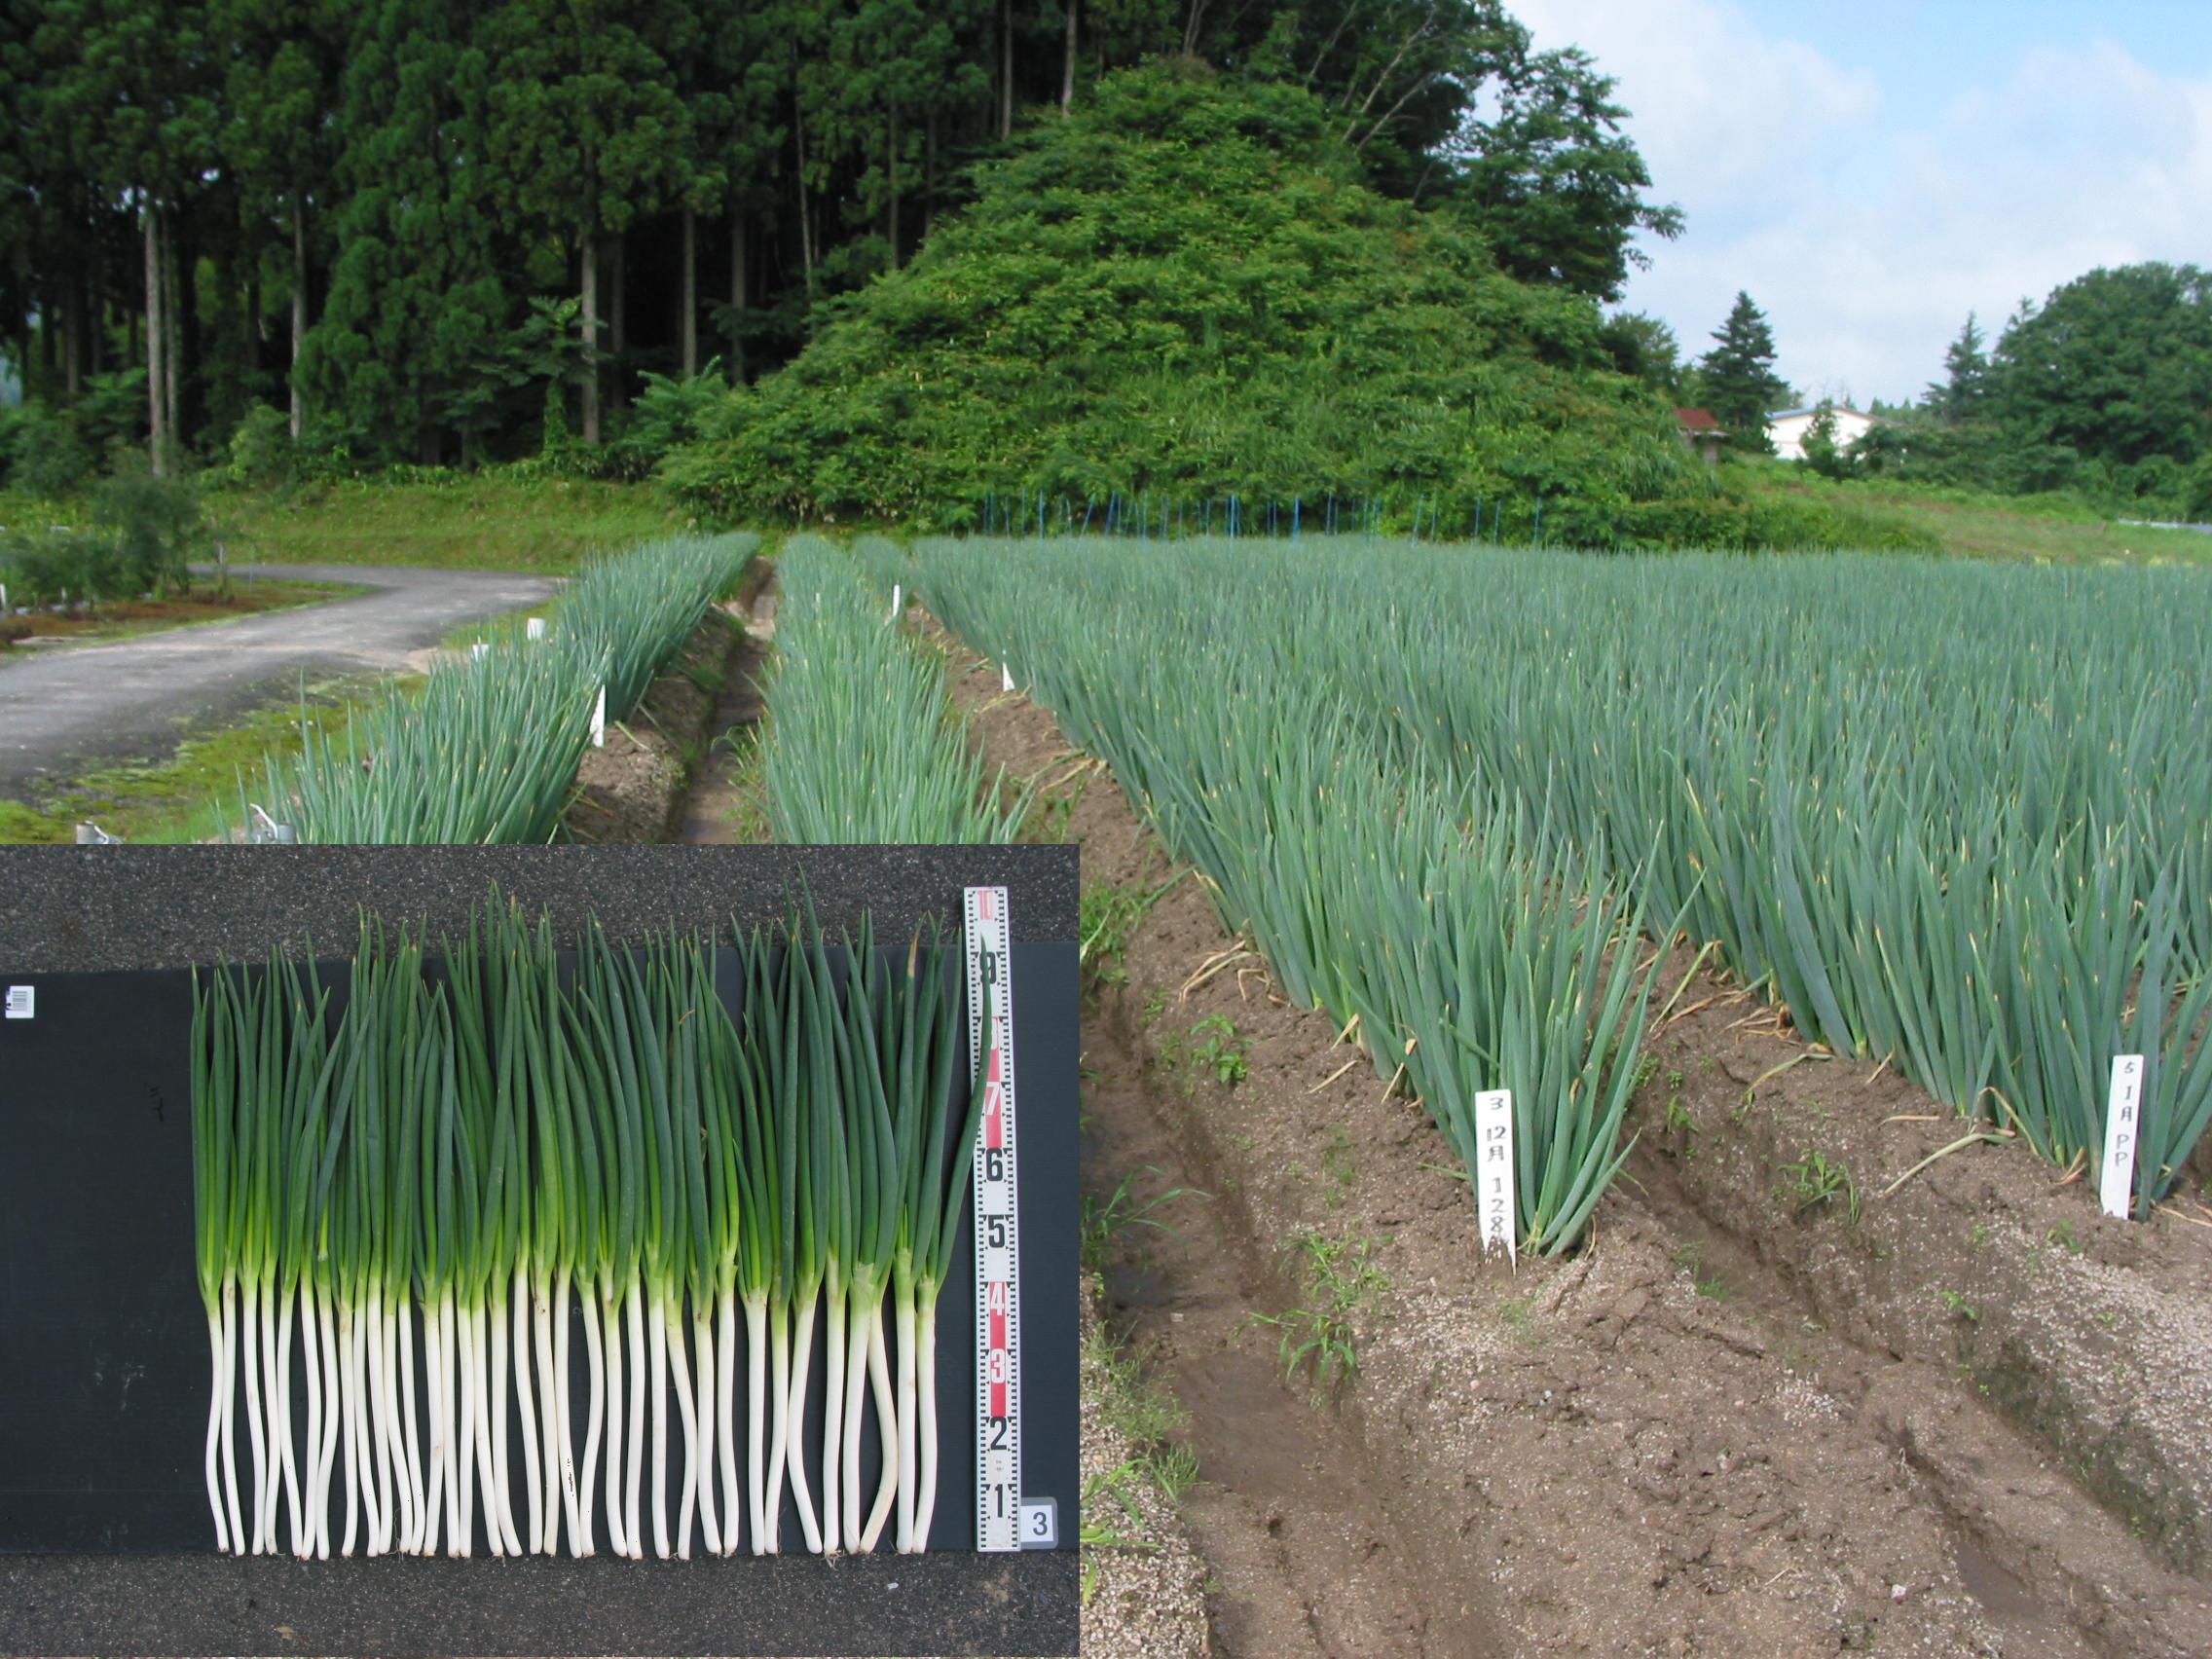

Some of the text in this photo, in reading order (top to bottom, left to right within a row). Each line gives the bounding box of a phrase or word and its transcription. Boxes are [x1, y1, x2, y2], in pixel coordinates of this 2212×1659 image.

[986, 1082, 1000, 1116] 7
[1489, 1097, 1504, 1110] 3
[985, 1148, 1004, 1182] 6
[987, 1215, 1005, 1248] 5
[990, 1282, 1004, 1316] 4
[990, 1348, 1006, 1383] 3
[990, 1417, 1008, 1451] 2
[994, 1484, 1004, 1518] 1
[1033, 1511, 1048, 1536] 3
